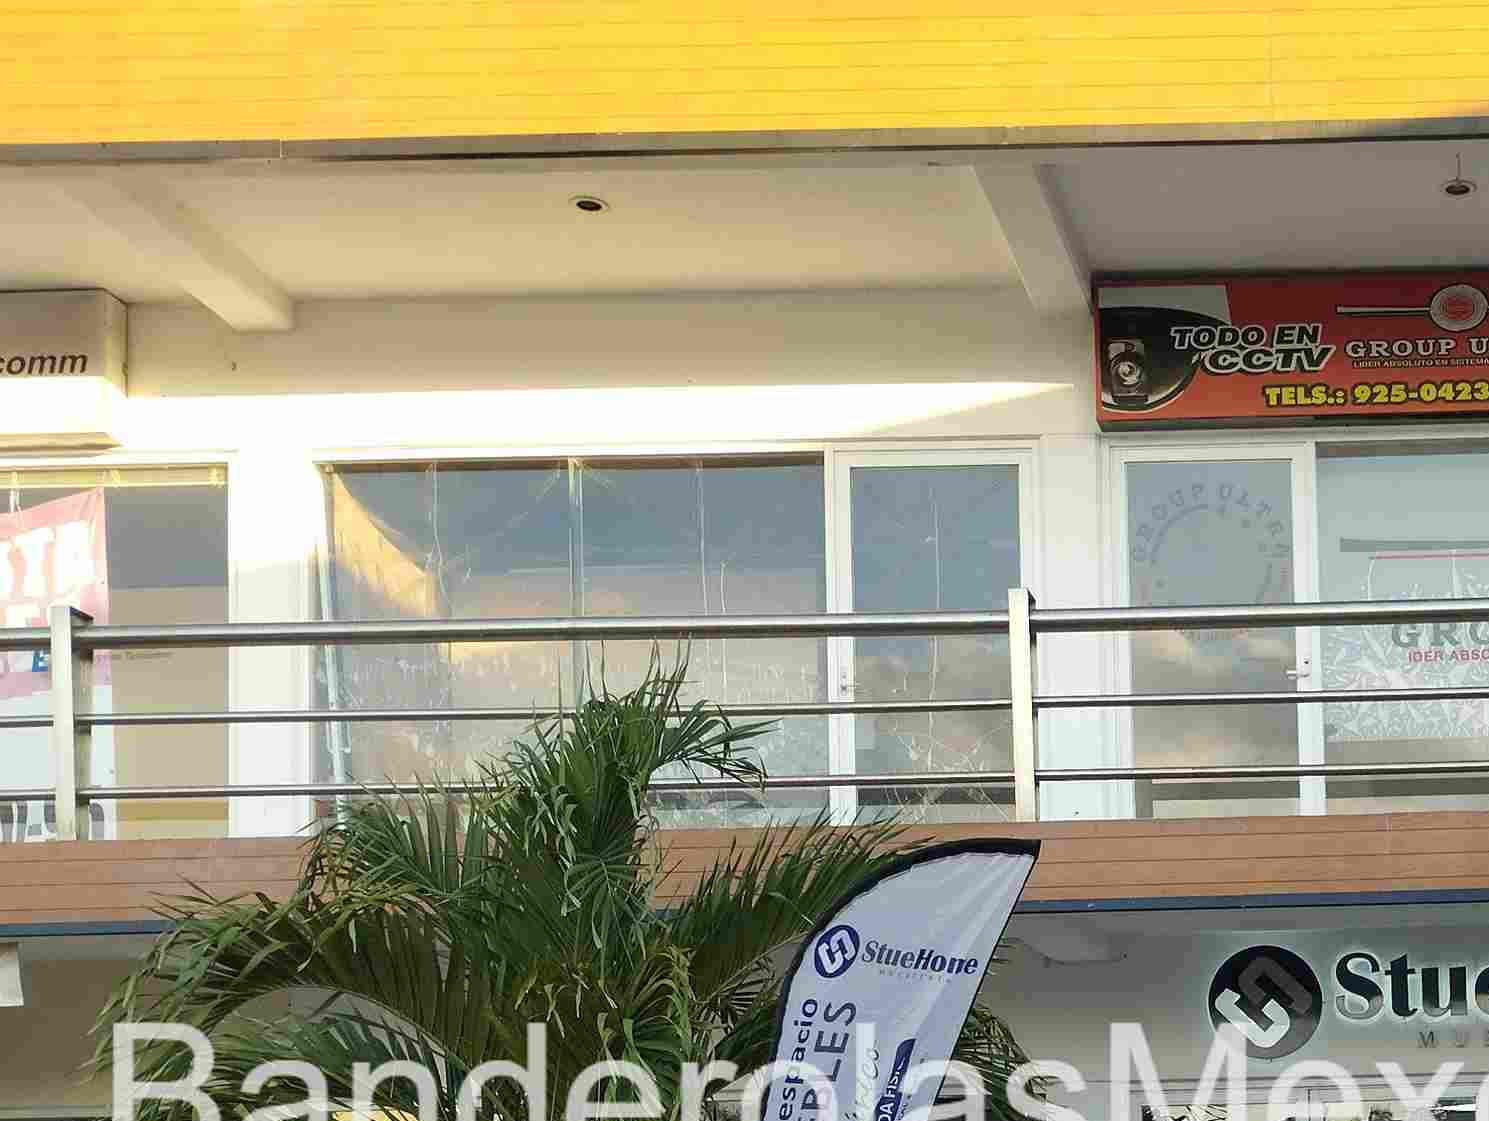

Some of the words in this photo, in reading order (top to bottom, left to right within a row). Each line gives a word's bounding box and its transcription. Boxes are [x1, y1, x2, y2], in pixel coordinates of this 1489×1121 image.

[1170, 325, 1266, 350] TODO
[1273, 323, 1322, 347] EN
[1345, 339, 1458, 358] GROUP
[1205, 345, 1337, 373] CCTV
[778, 998, 819, 1119] espacio
